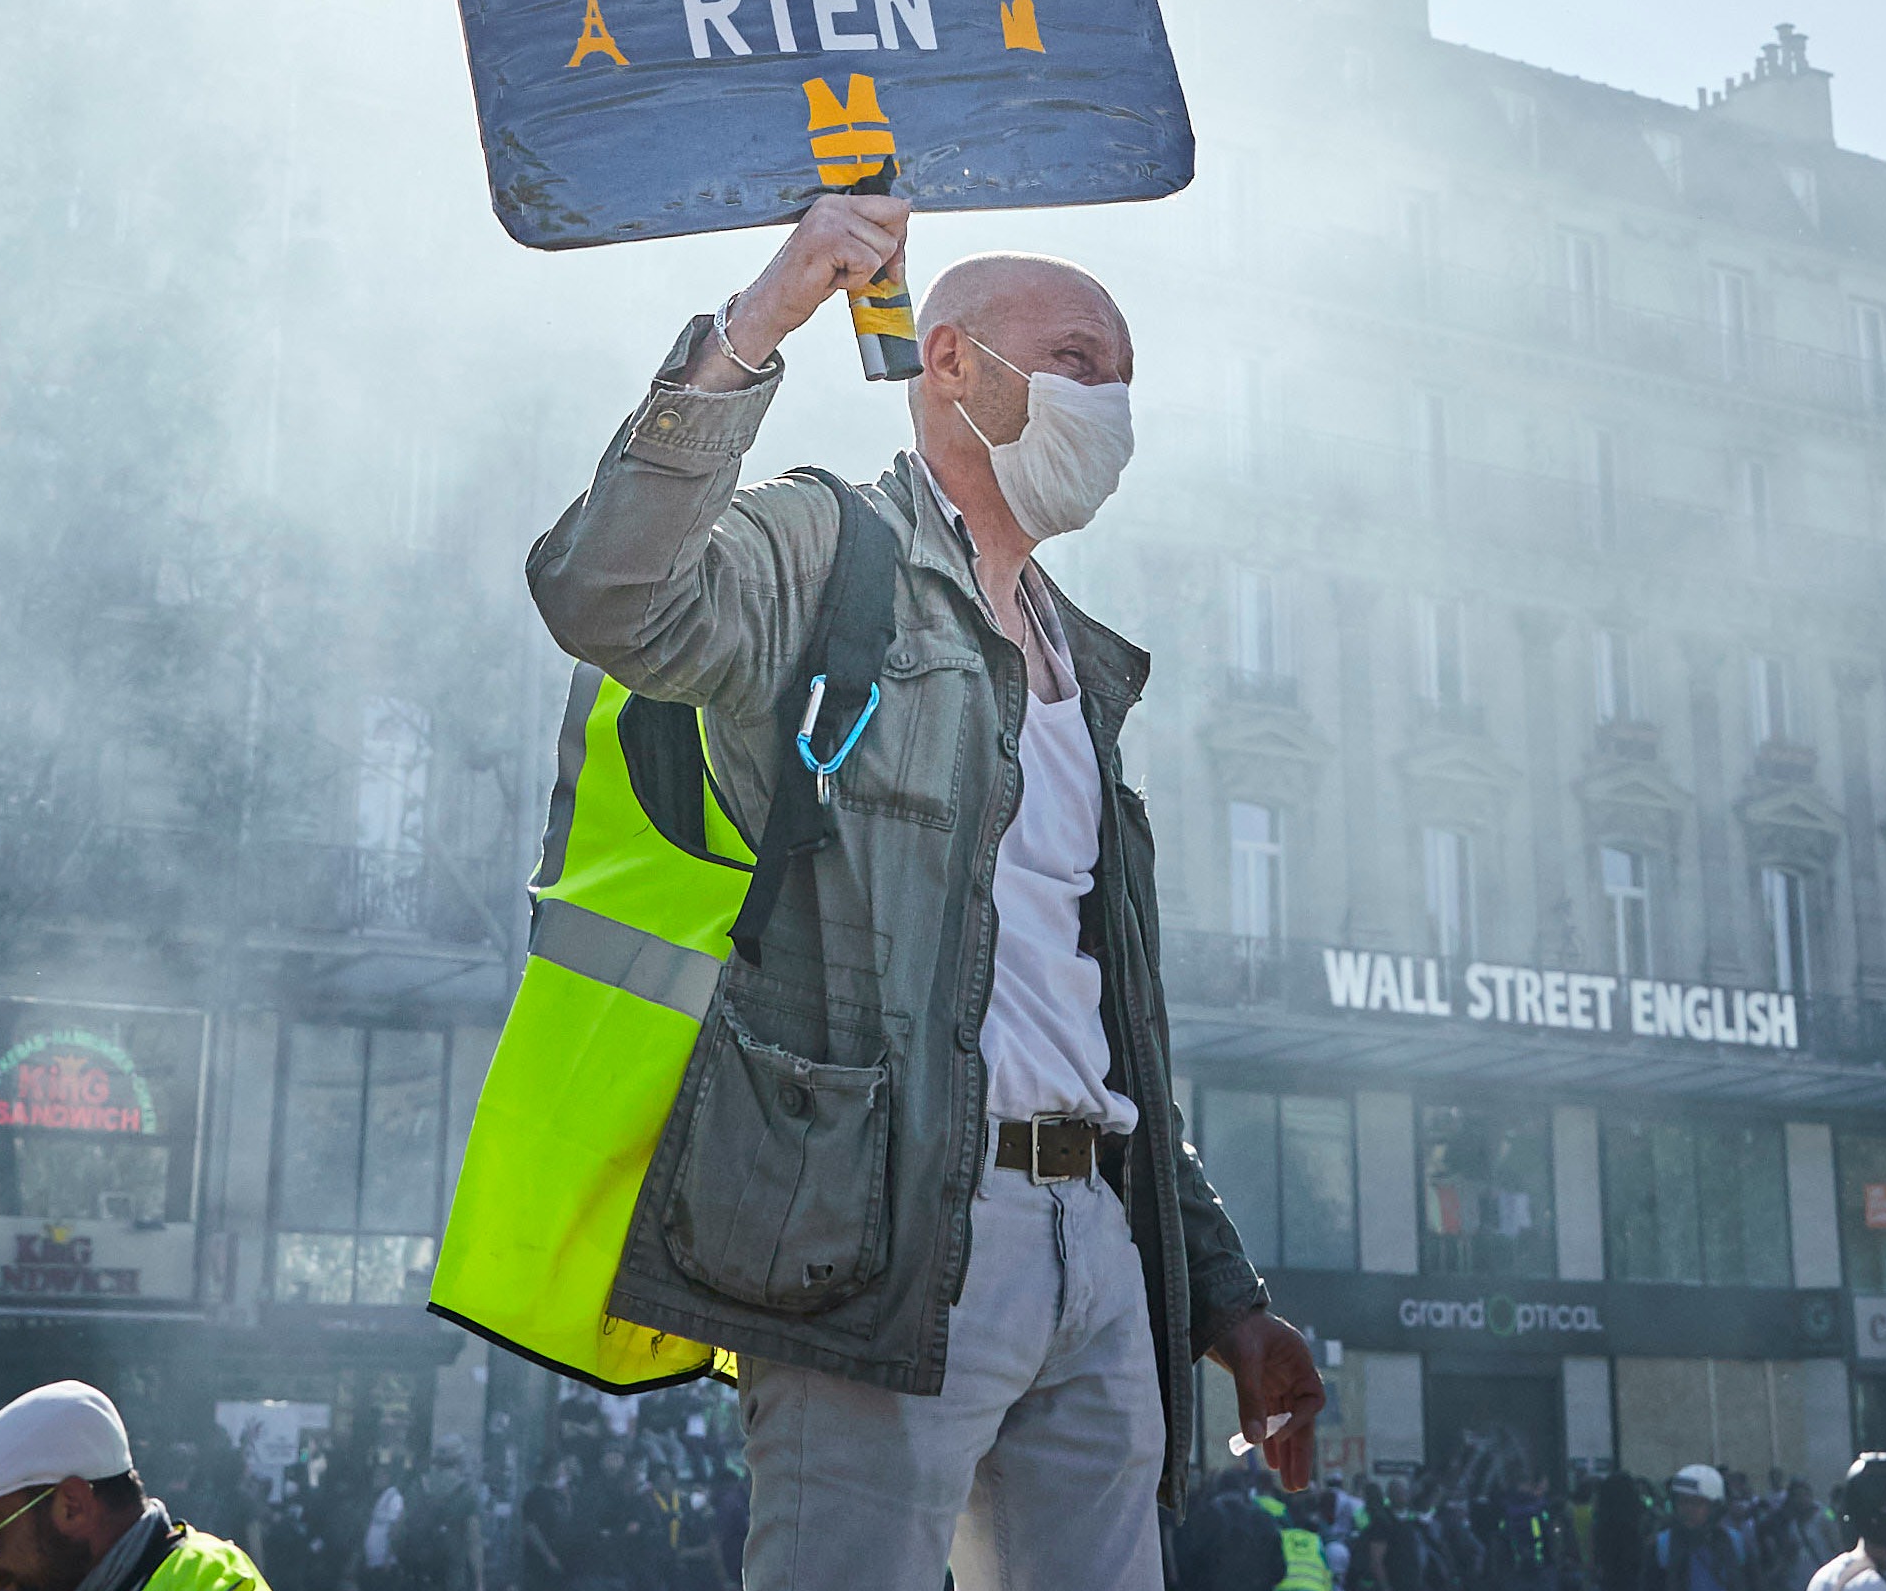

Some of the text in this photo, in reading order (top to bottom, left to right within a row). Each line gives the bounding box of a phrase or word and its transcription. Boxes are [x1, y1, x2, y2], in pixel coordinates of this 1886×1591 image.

[1322, 947, 1797, 1049] WALL STREET ENGLISH
